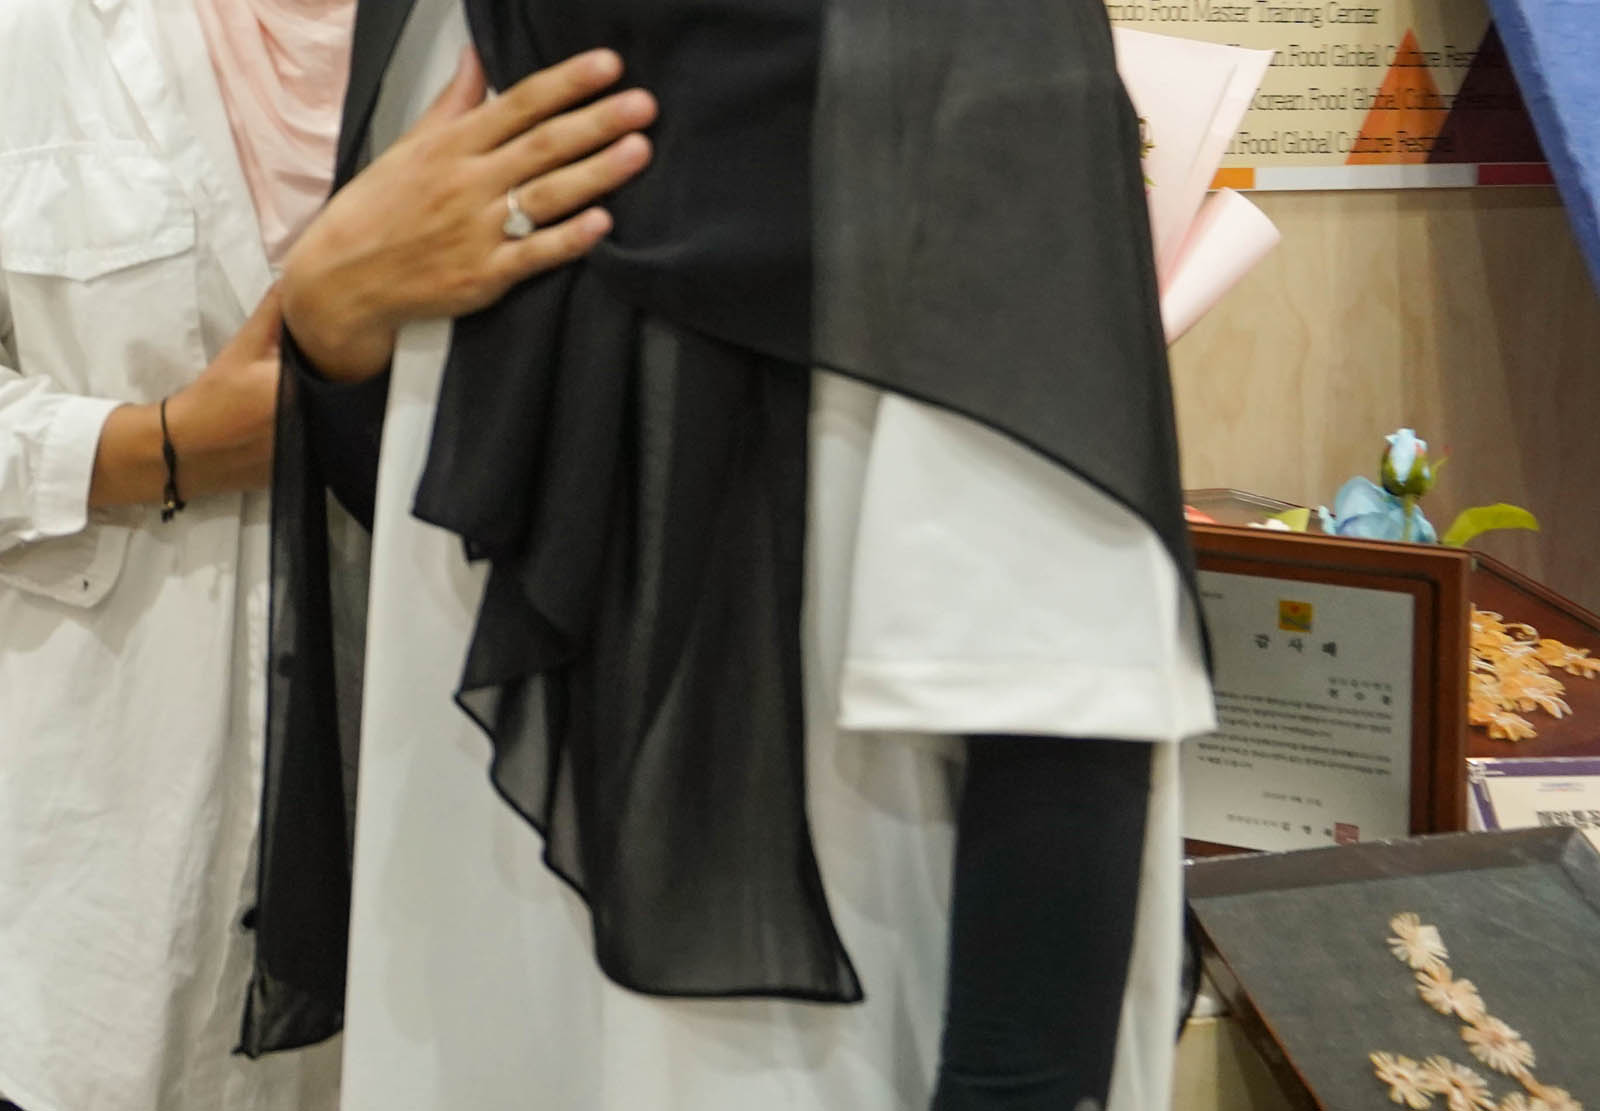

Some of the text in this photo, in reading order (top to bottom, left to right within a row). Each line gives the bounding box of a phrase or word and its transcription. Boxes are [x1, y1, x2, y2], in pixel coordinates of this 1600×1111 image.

[1148, 0, 1189, 23] Food
[1193, 0, 1252, 25] Master
[1255, 0, 1324, 28] Training
[1326, 1, 1380, 25] Center
[1286, 45, 1328, 67] Food
[1330, 45, 1381, 68] Global
[1307, 88, 1348, 110] Food
[1238, 131, 1280, 154] Food
[1283, 131, 1332, 154] Global
